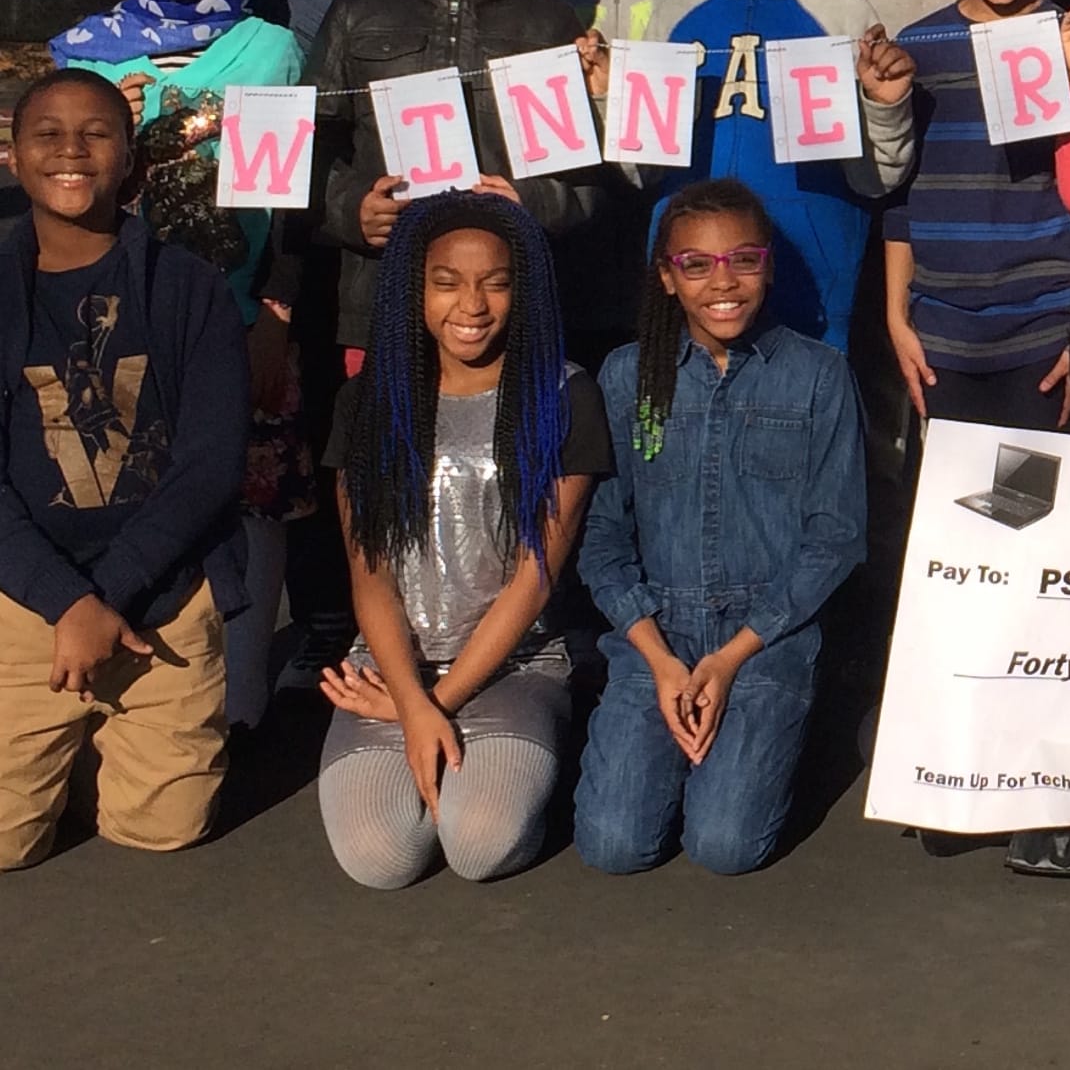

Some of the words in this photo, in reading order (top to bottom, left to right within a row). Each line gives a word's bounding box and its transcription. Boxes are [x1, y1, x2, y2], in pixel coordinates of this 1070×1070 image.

[927, 560, 971, 585] Pay
[977, 564, 1010, 586] To:
[915, 766, 965, 788] Team
[970, 773, 989, 791] Up
[997, 773, 1027, 788] For
